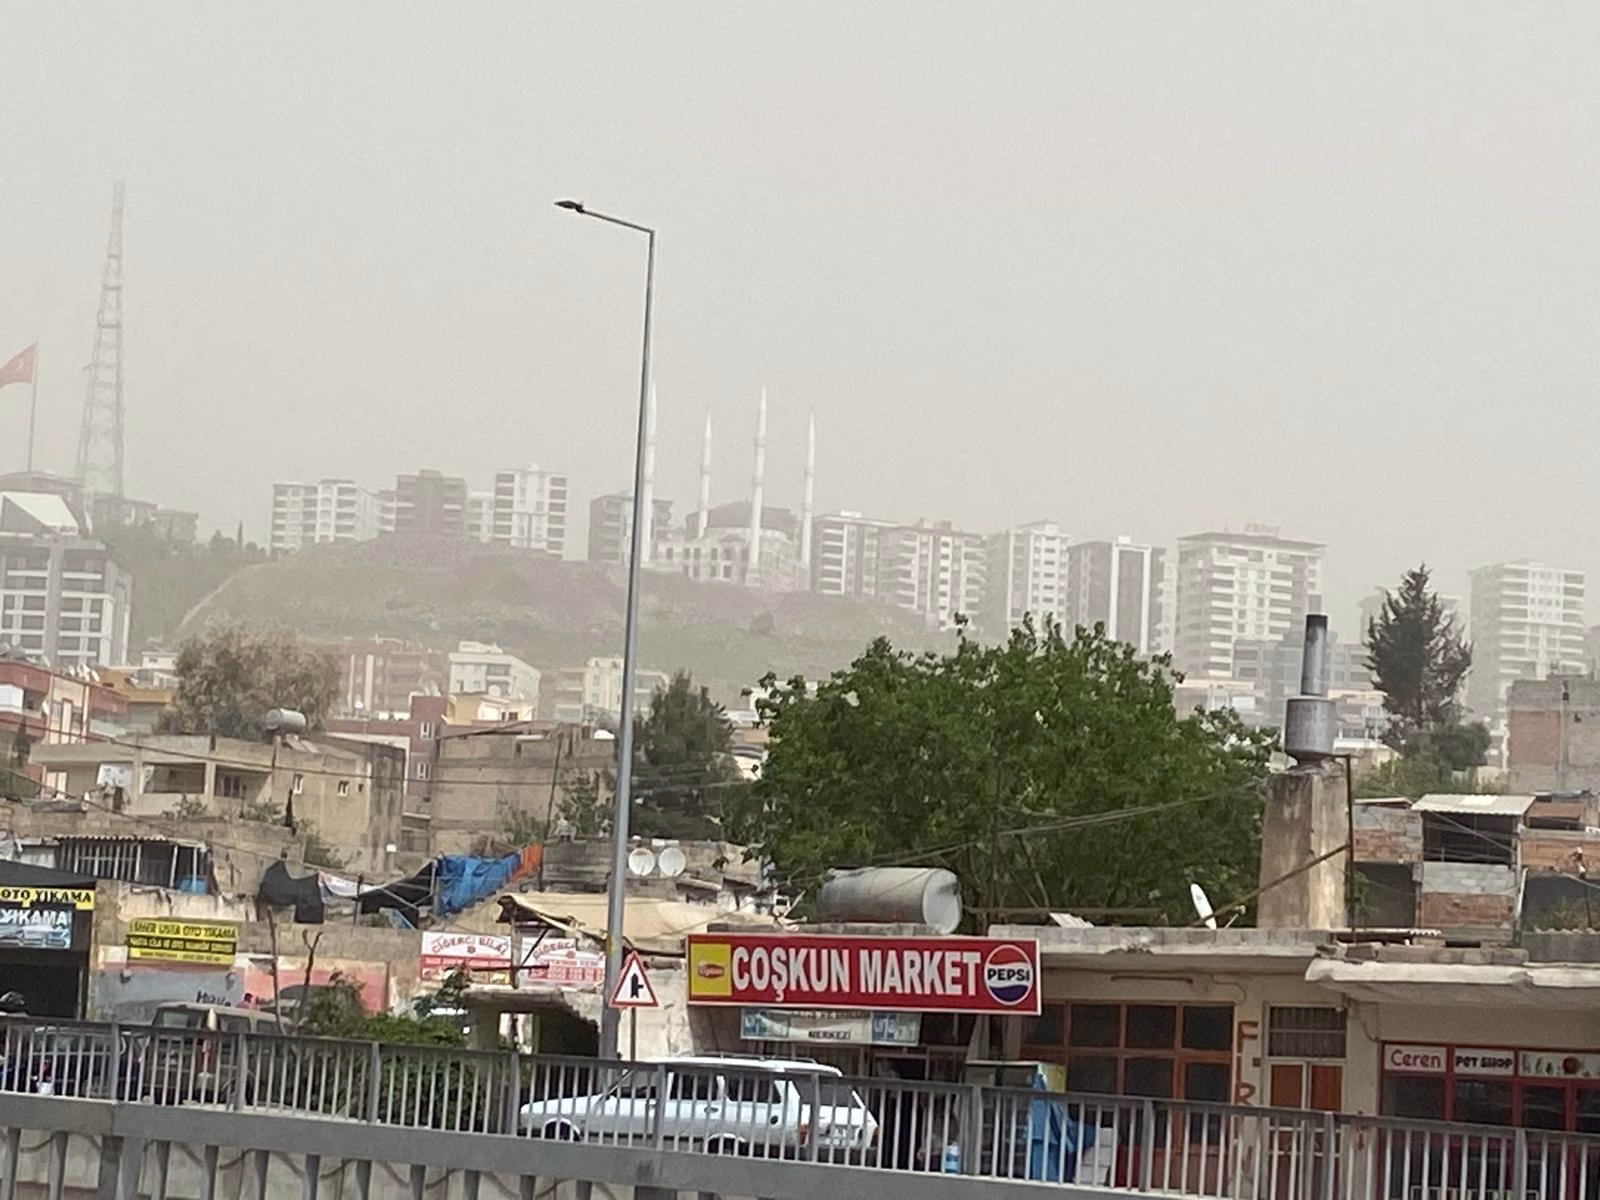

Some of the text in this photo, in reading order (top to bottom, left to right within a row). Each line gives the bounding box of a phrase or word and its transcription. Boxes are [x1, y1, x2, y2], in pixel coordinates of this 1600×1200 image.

[1, 889, 92, 903] OTO YIKAMA
[732, 945, 1031, 1002] COŞKUN MARKET PEPSI
[1390, 1049, 1441, 1069] Ceren
